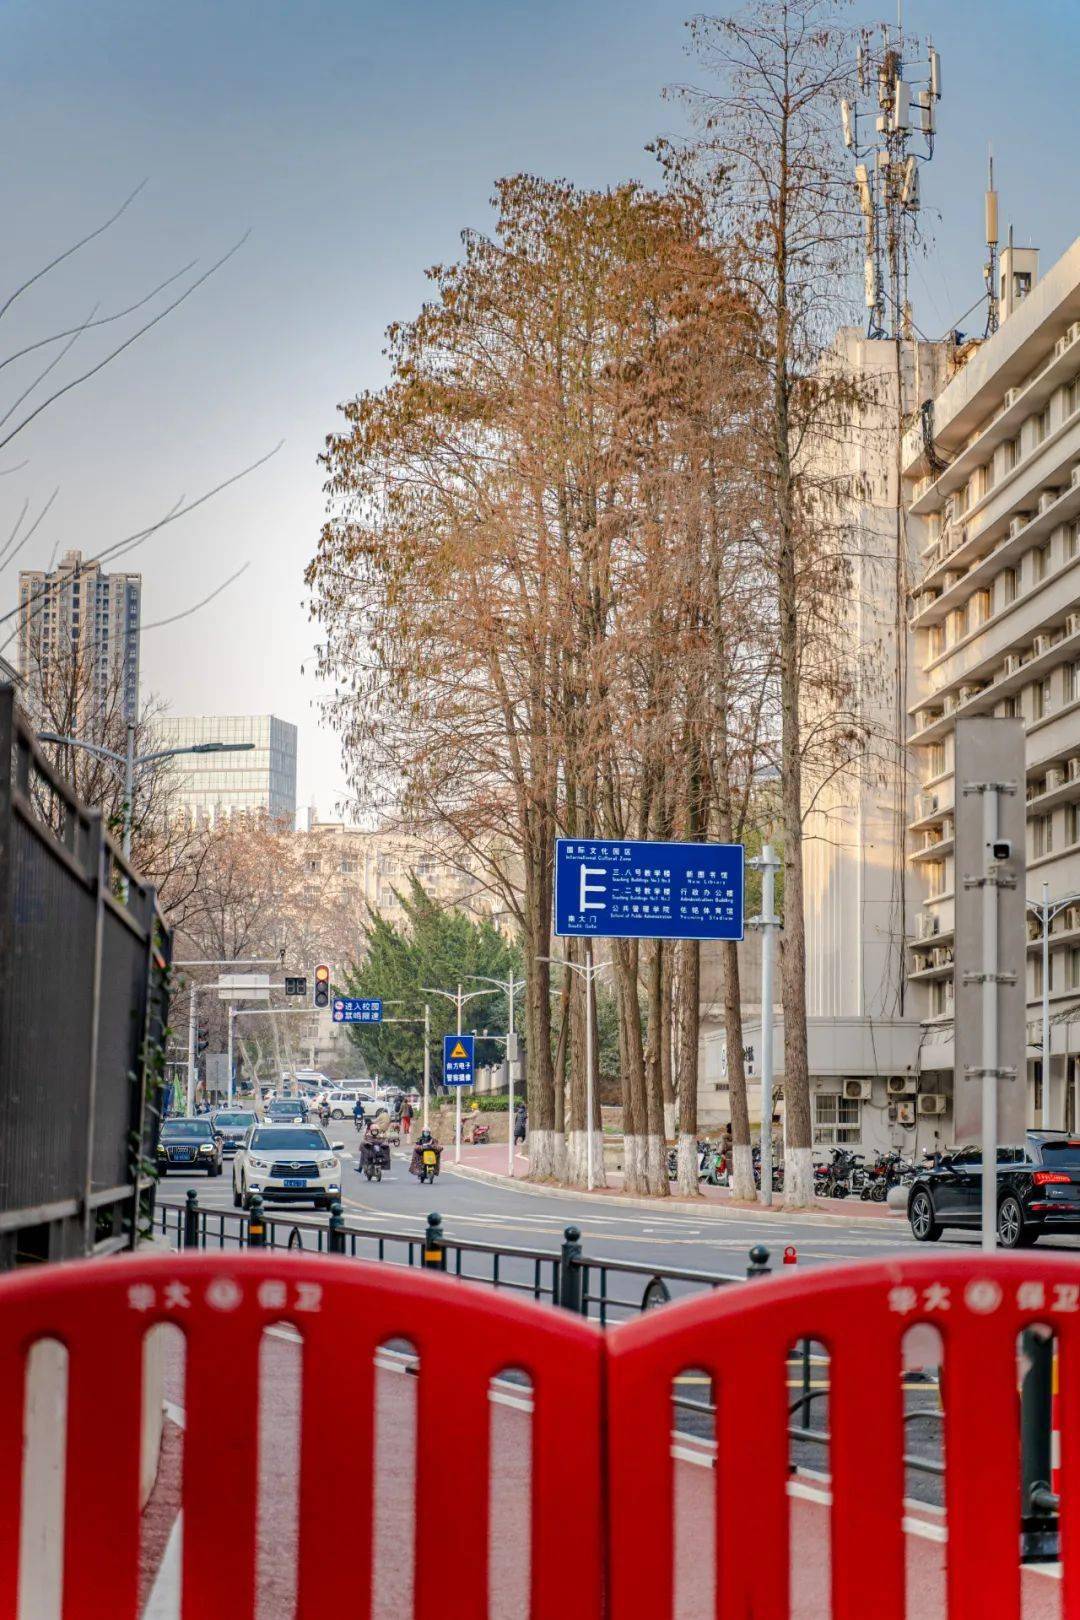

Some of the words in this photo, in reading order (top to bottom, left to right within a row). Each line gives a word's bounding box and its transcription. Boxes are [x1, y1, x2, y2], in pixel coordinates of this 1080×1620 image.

[566, 846, 631, 855] 国际文化园区
[680, 888, 733, 897] 行政办公楼
[612, 905, 670, 913] 公共管理学院
[345, 1002, 379, 1010] 进入校园
[345, 1012, 379, 1020] 禁鸣限速
